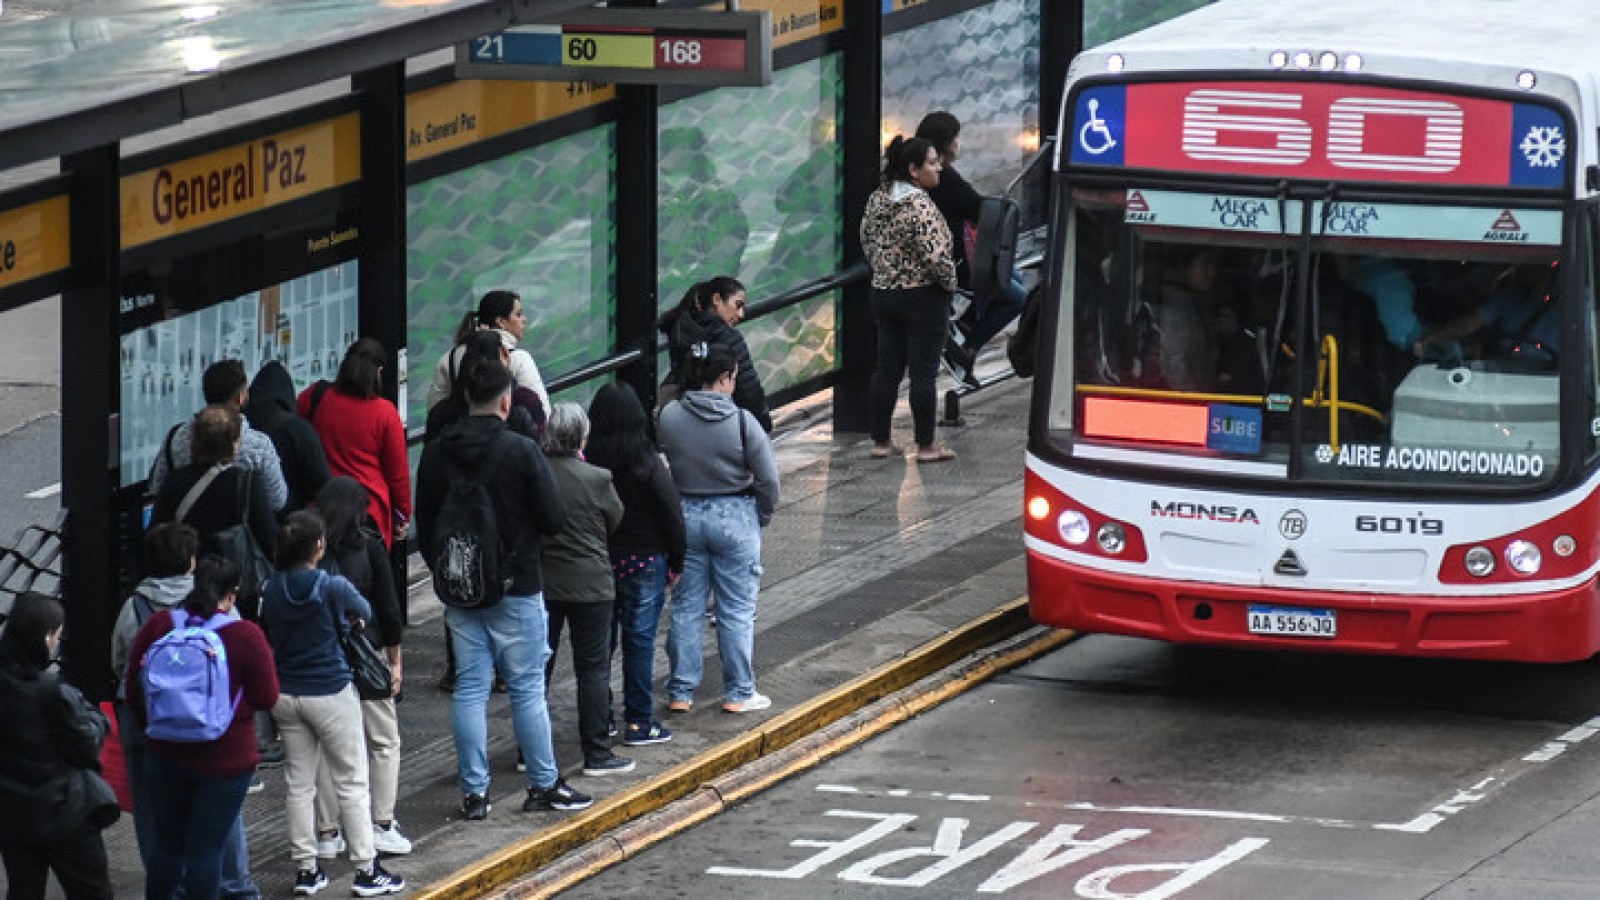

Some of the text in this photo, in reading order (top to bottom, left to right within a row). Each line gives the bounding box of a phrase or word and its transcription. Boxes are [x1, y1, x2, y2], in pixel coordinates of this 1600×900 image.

[477, 35, 503, 59] 21
[568, 38, 597, 61] 60
[660, 40, 702, 64] 168
[1182, 88, 1464, 173] 60
[152, 139, 307, 225] General Paz
[1211, 197, 1269, 215] MEGA
[1219, 211, 1258, 229] CAR
[1328, 216, 1369, 234] CAR
[1483, 230, 1530, 241] AGRALE
[1210, 415, 1257, 438] SUBE
[1337, 444, 1544, 477] AIRE ACONDICIONADO
[1150, 499, 1261, 525] MONSA
[1354, 515, 1444, 536] 6019
[1252, 614, 1272, 630] AA
[706, 809, 1271, 900] PARE
